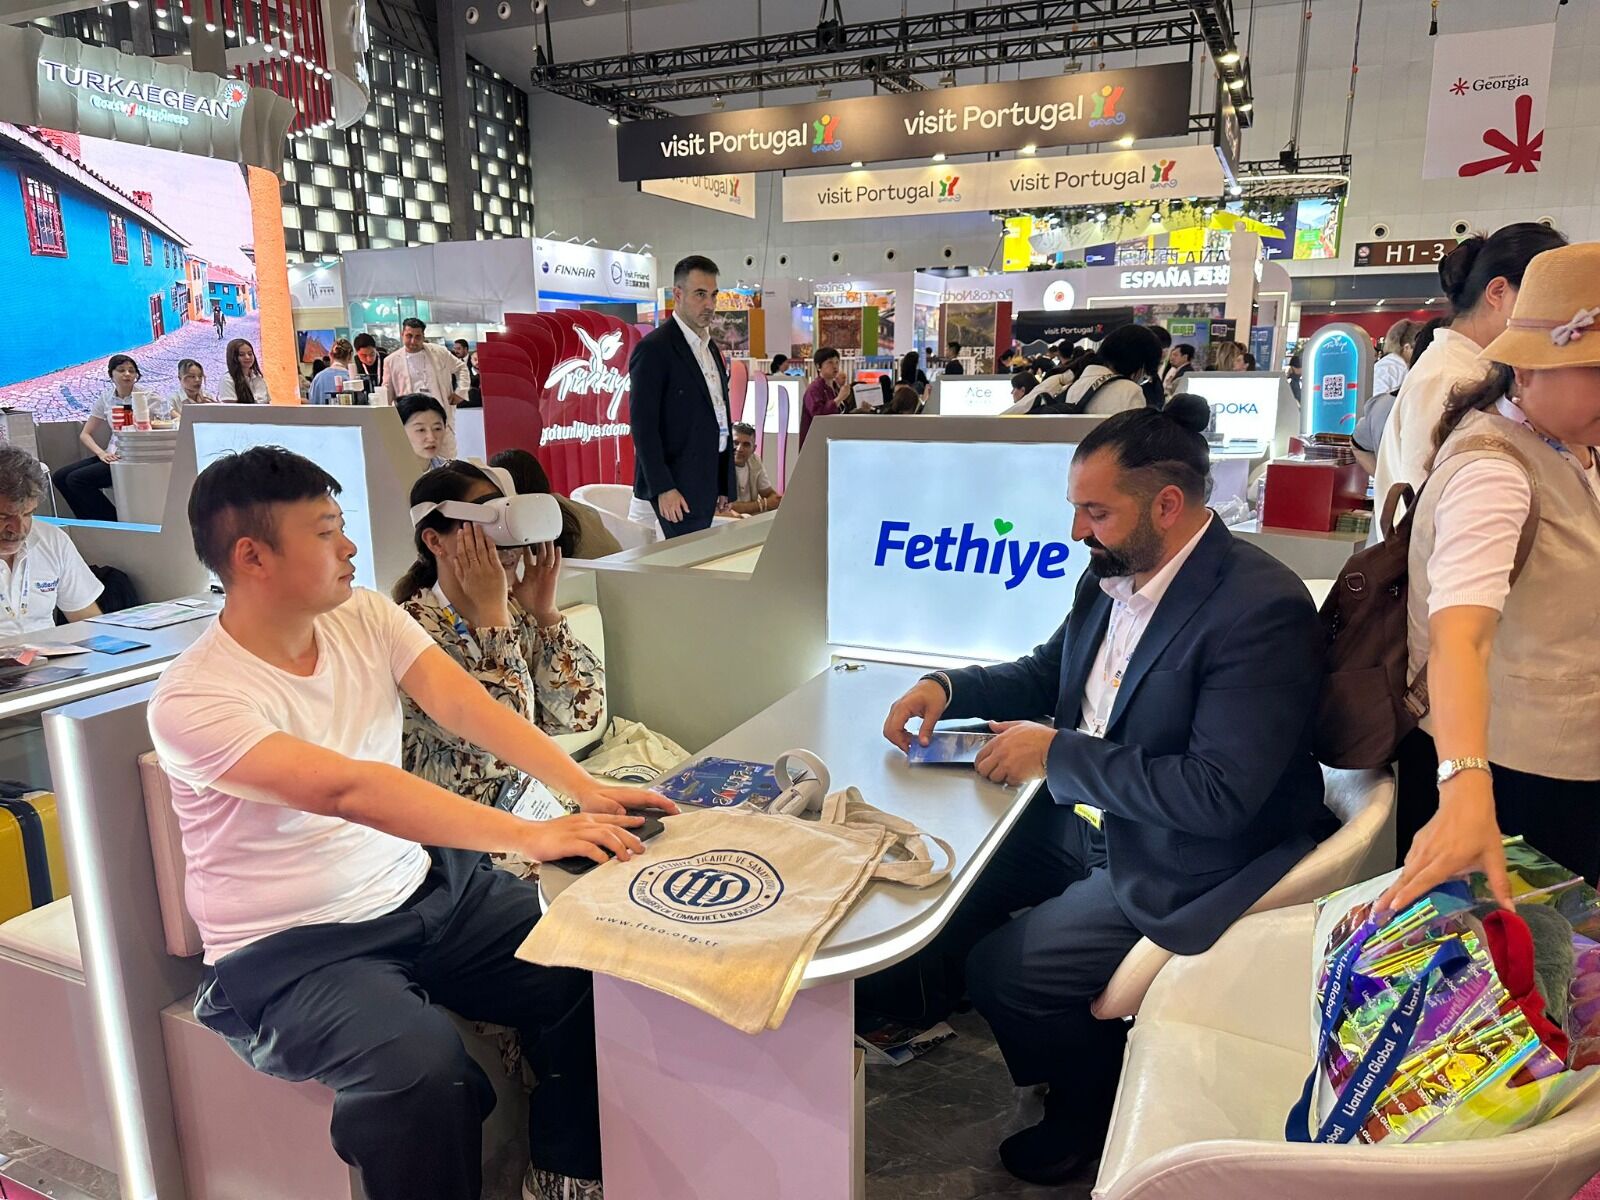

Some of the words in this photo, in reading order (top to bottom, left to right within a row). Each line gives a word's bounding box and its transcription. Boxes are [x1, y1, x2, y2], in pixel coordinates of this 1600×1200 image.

[39, 57, 231, 119] TURKAEGEAN
[1472, 75, 1529, 91] Georgia
[903, 110, 957, 136] visit
[962, 95, 1084, 132] Portugal
[660, 133, 706, 158] visit
[709, 122, 808, 156] Portugal
[817, 186, 853, 205] visit
[856, 180, 934, 204] Portugal
[1009, 173, 1051, 193] visit
[1054, 165, 1146, 191] Portugal
[1385, 243, 1446, 263] H1-3
[554, 264, 597, 279] FINNAIR
[1120, 267, 1192, 289] ESPAÑA
[1044, 326, 1060, 336] visit
[1060, 325, 1094, 336] Portugal
[873, 518, 1070, 591] Fethiye
[593, 915, 719, 948] www.ftso.org.tr
[1325, 980, 1341, 1019] Global
[1343, 1070, 1377, 1118] LianLian
[1366, 1037, 1397, 1074] Global
